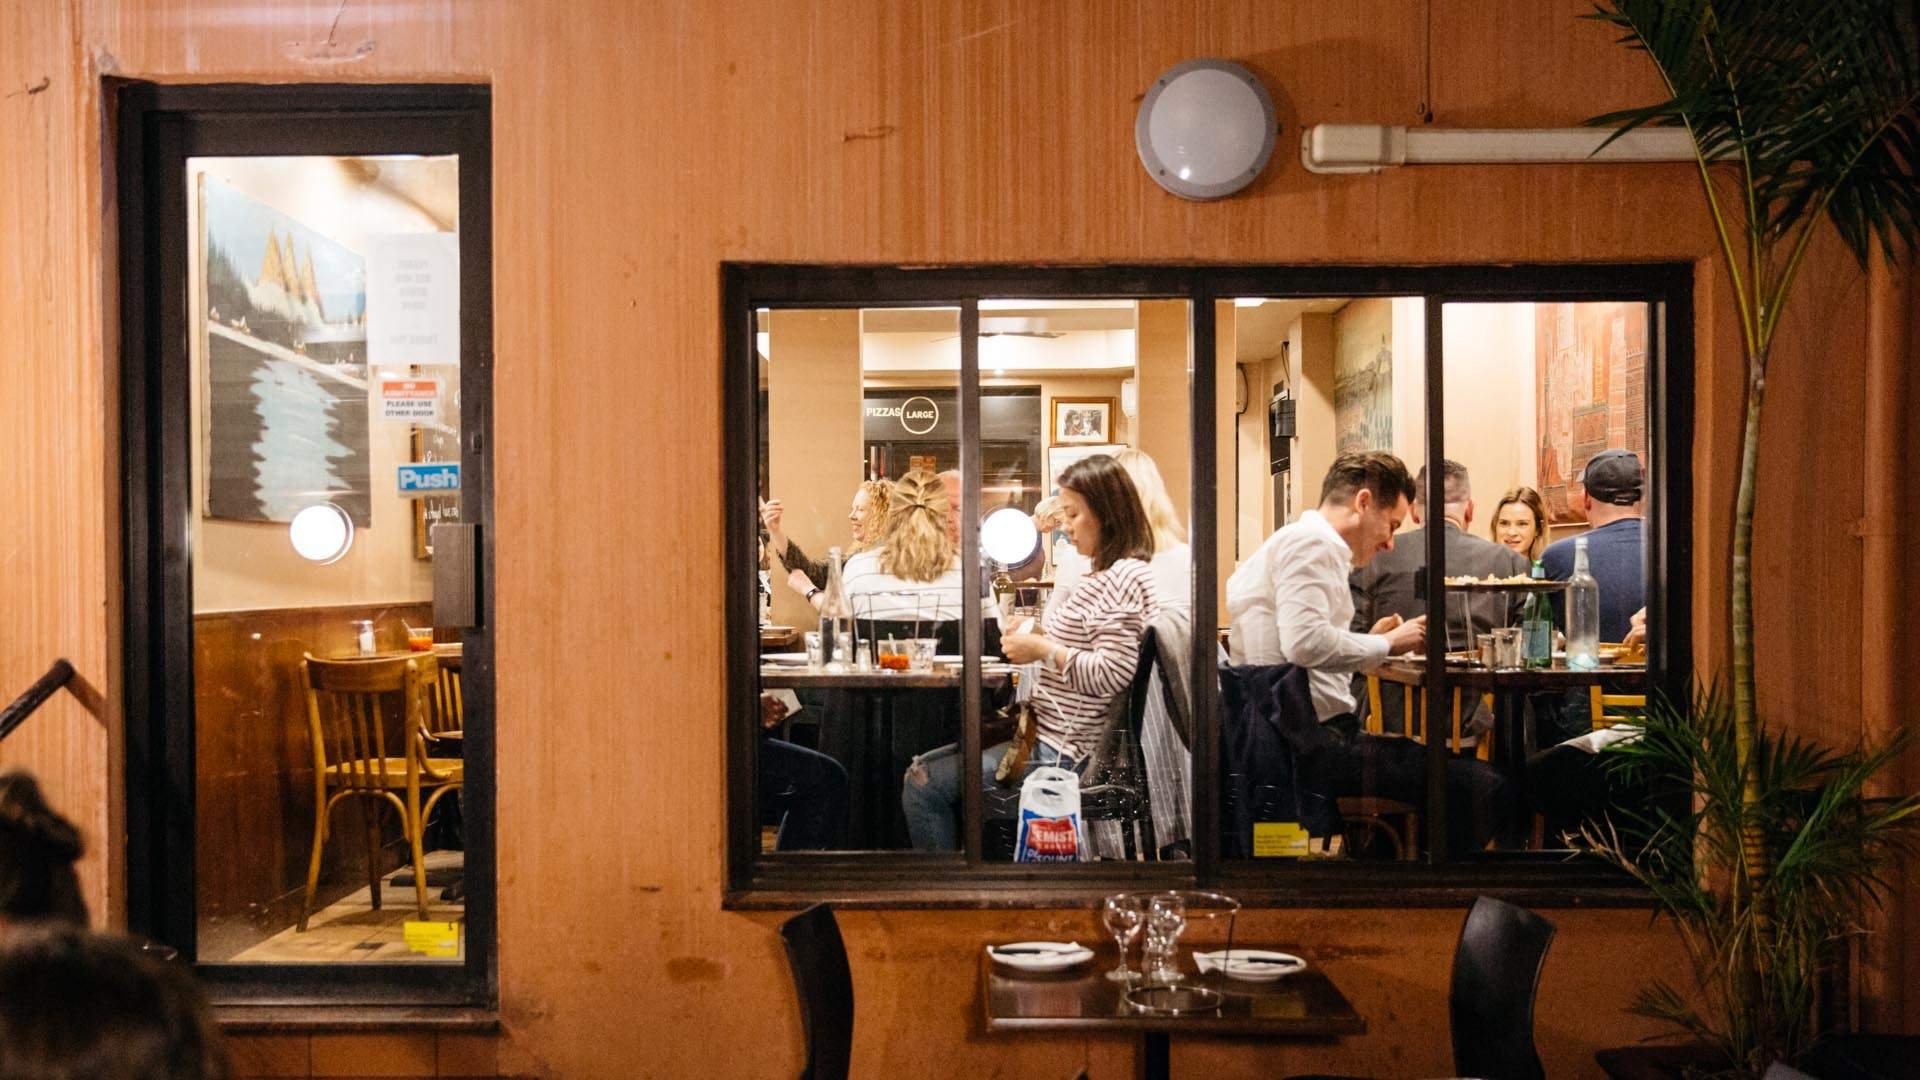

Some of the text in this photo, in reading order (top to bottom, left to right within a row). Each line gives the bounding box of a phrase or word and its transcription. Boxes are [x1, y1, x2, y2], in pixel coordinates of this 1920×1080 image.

[386, 400, 433, 408] PLEASE USE
[866, 407, 901, 417] PIZZAS
[906, 410, 934, 419] LARGE
[400, 468, 458, 489] Push
